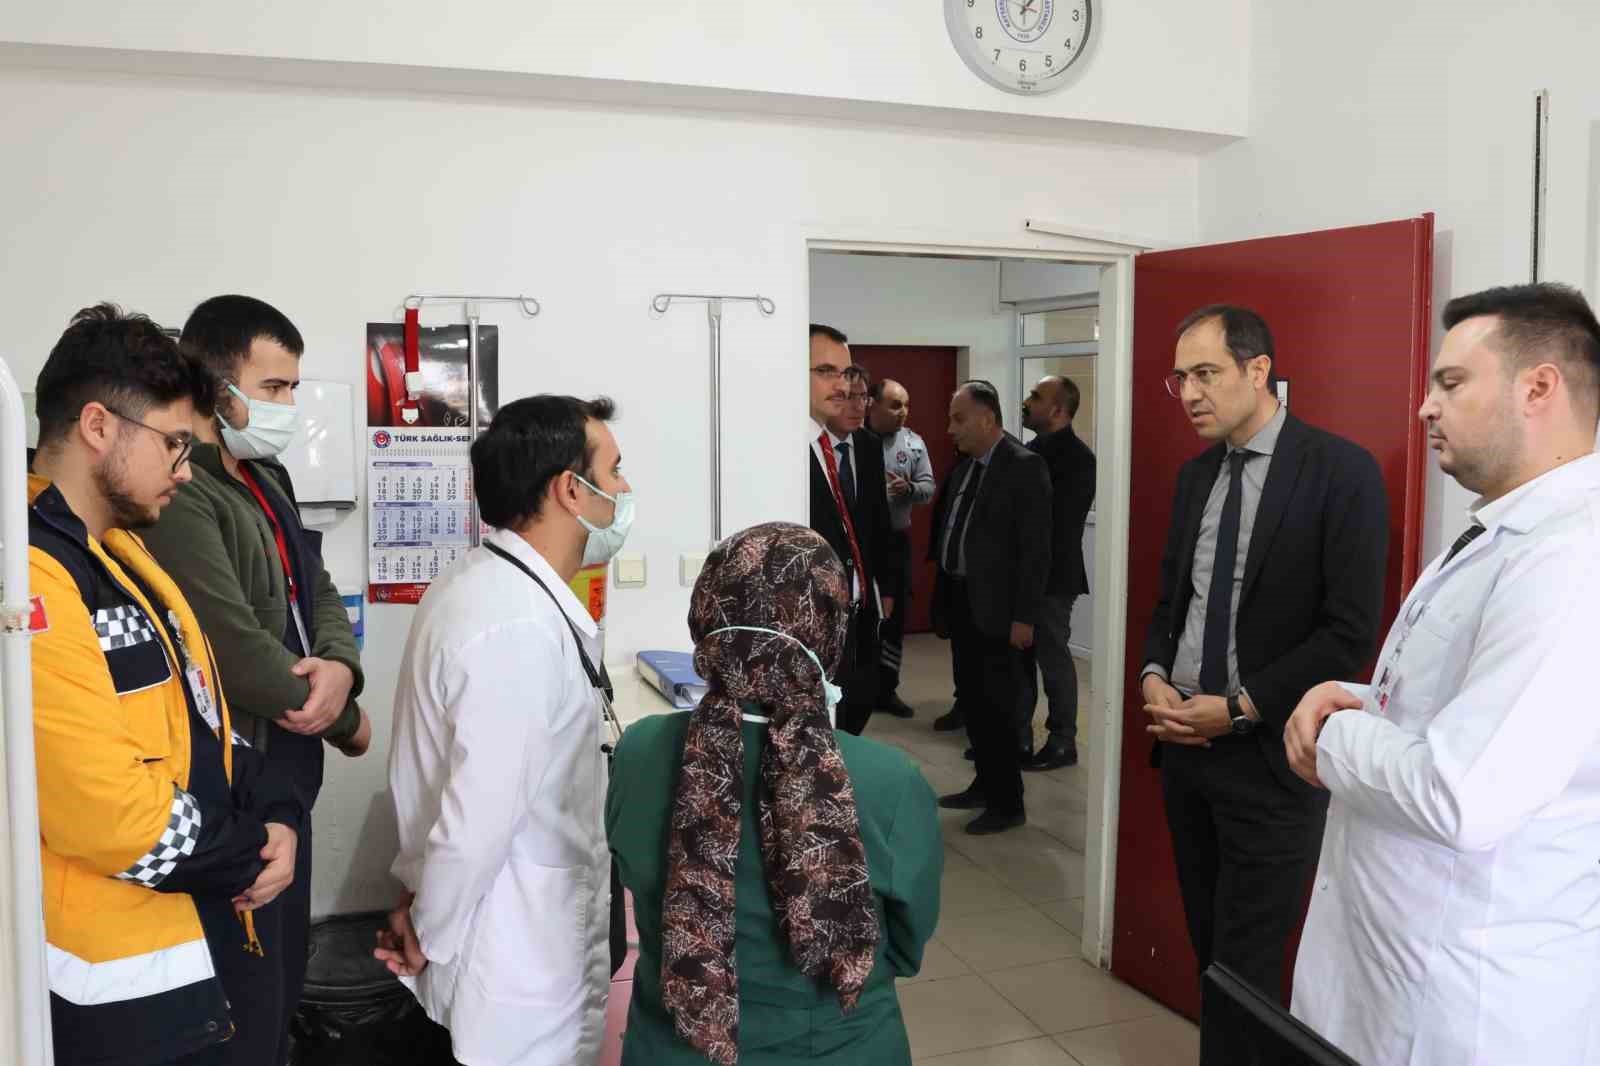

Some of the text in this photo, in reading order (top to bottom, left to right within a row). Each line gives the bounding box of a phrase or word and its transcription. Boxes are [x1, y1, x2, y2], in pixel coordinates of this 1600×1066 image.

[1072, 9, 1080, 22] 3
[975, 26, 983, 39] 8
[1064, 38, 1072, 50] 4
[993, 49, 1001, 61] 7
[1045, 55, 1053, 68] 5
[1019, 59, 1027, 72] 6
[394, 433, 418, 442] TÜRK
